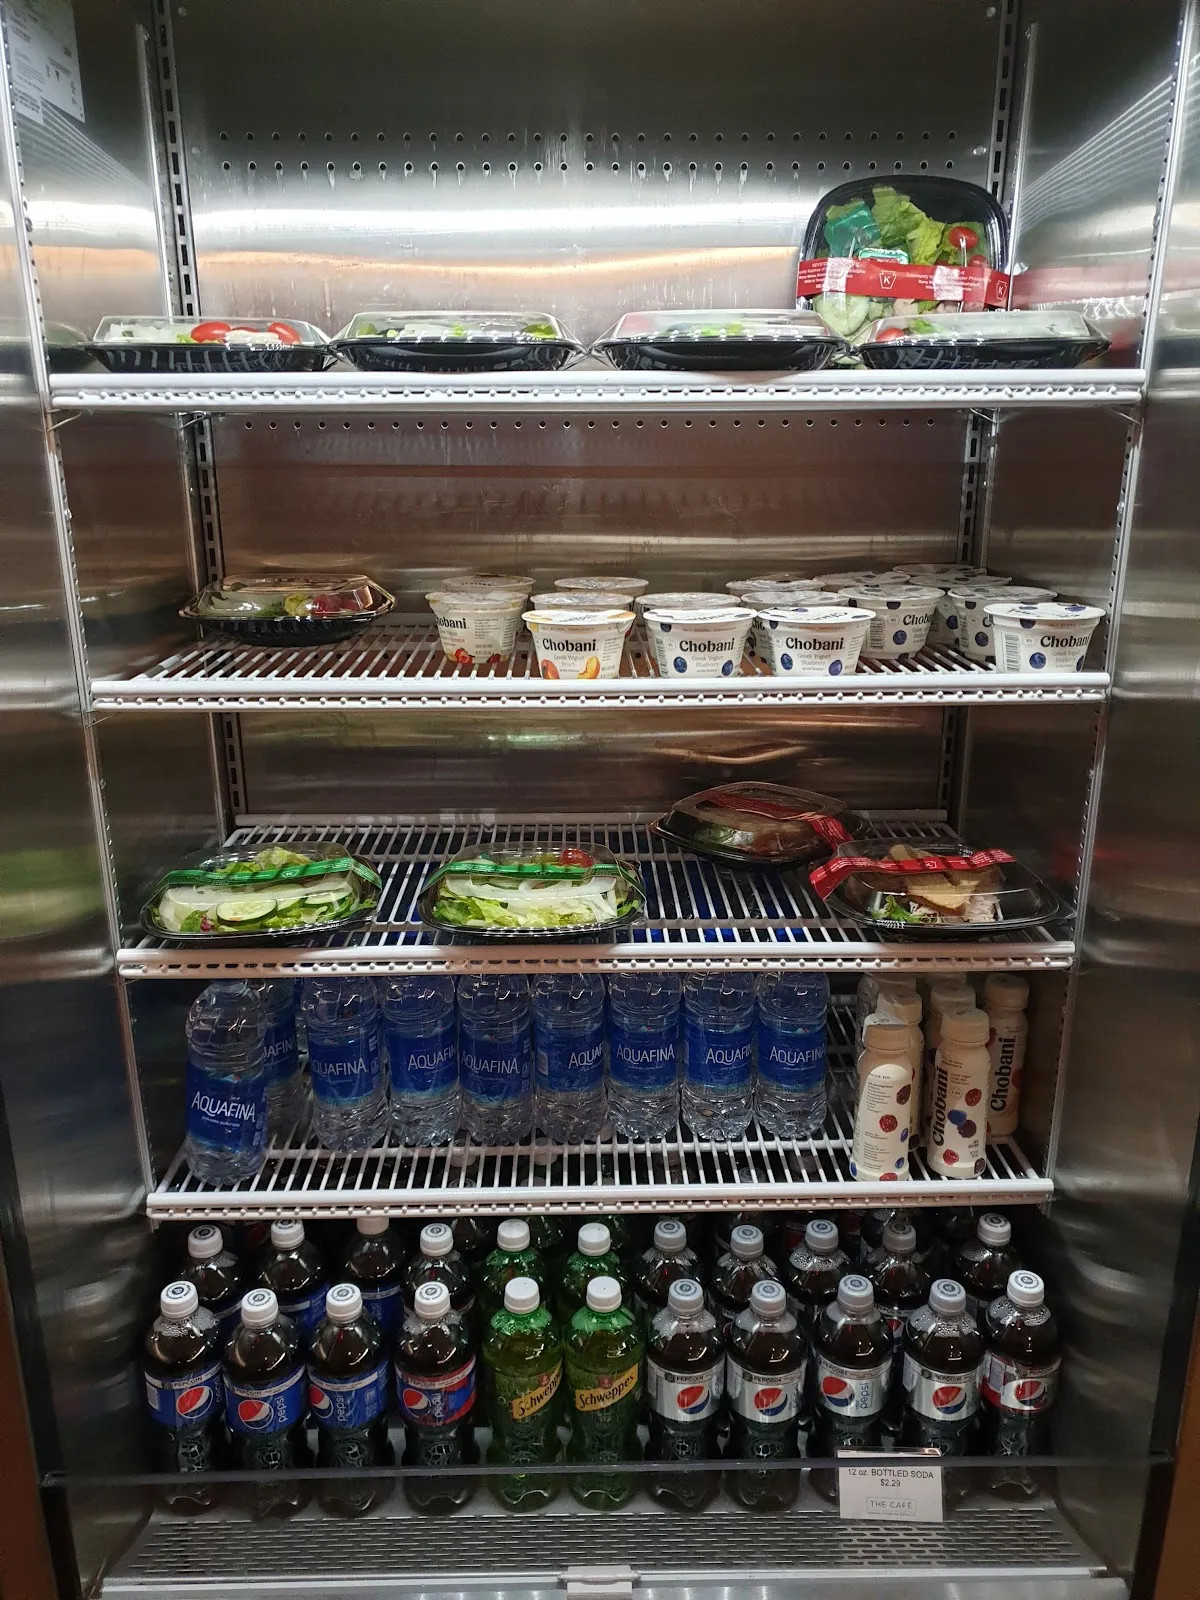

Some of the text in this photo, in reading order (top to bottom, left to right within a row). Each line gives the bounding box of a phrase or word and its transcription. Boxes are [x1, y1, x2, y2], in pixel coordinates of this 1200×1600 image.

[437, 616, 467, 630] obani
[903, 613, 931, 626] Chob
[542, 637, 598, 652] Chobani
[679, 637, 736, 653] Chobani
[786, 636, 844, 651] Chobani
[1040, 633, 1090, 648] Chobani
[568, 1042, 604, 1070] AQUAF
[616, 1043, 676, 1065] AQUAFINA
[312, 1057, 369, 1078] QUAFINA
[990, 1036, 1017, 1112] Chobani
[191, 1090, 256, 1123] AQUAFINA
[932, 1065, 949, 1147] Chobani
[518, 1373, 560, 1417] Schwepp
[579, 1373, 634, 1409] Schweppes
[859, 1382, 871, 1410] pepsi
[275, 1395, 289, 1423] pepsi
[335, 1395, 349, 1422] pepsi
[848, 1468, 857, 1476] 12
[871, 1469, 909, 1478] BOTTLED
[910, 1470, 935, 1479] SODA
[880, 1478, 901, 1487] $2.29
[870, 1500, 912, 1510] THE CAFÉ
